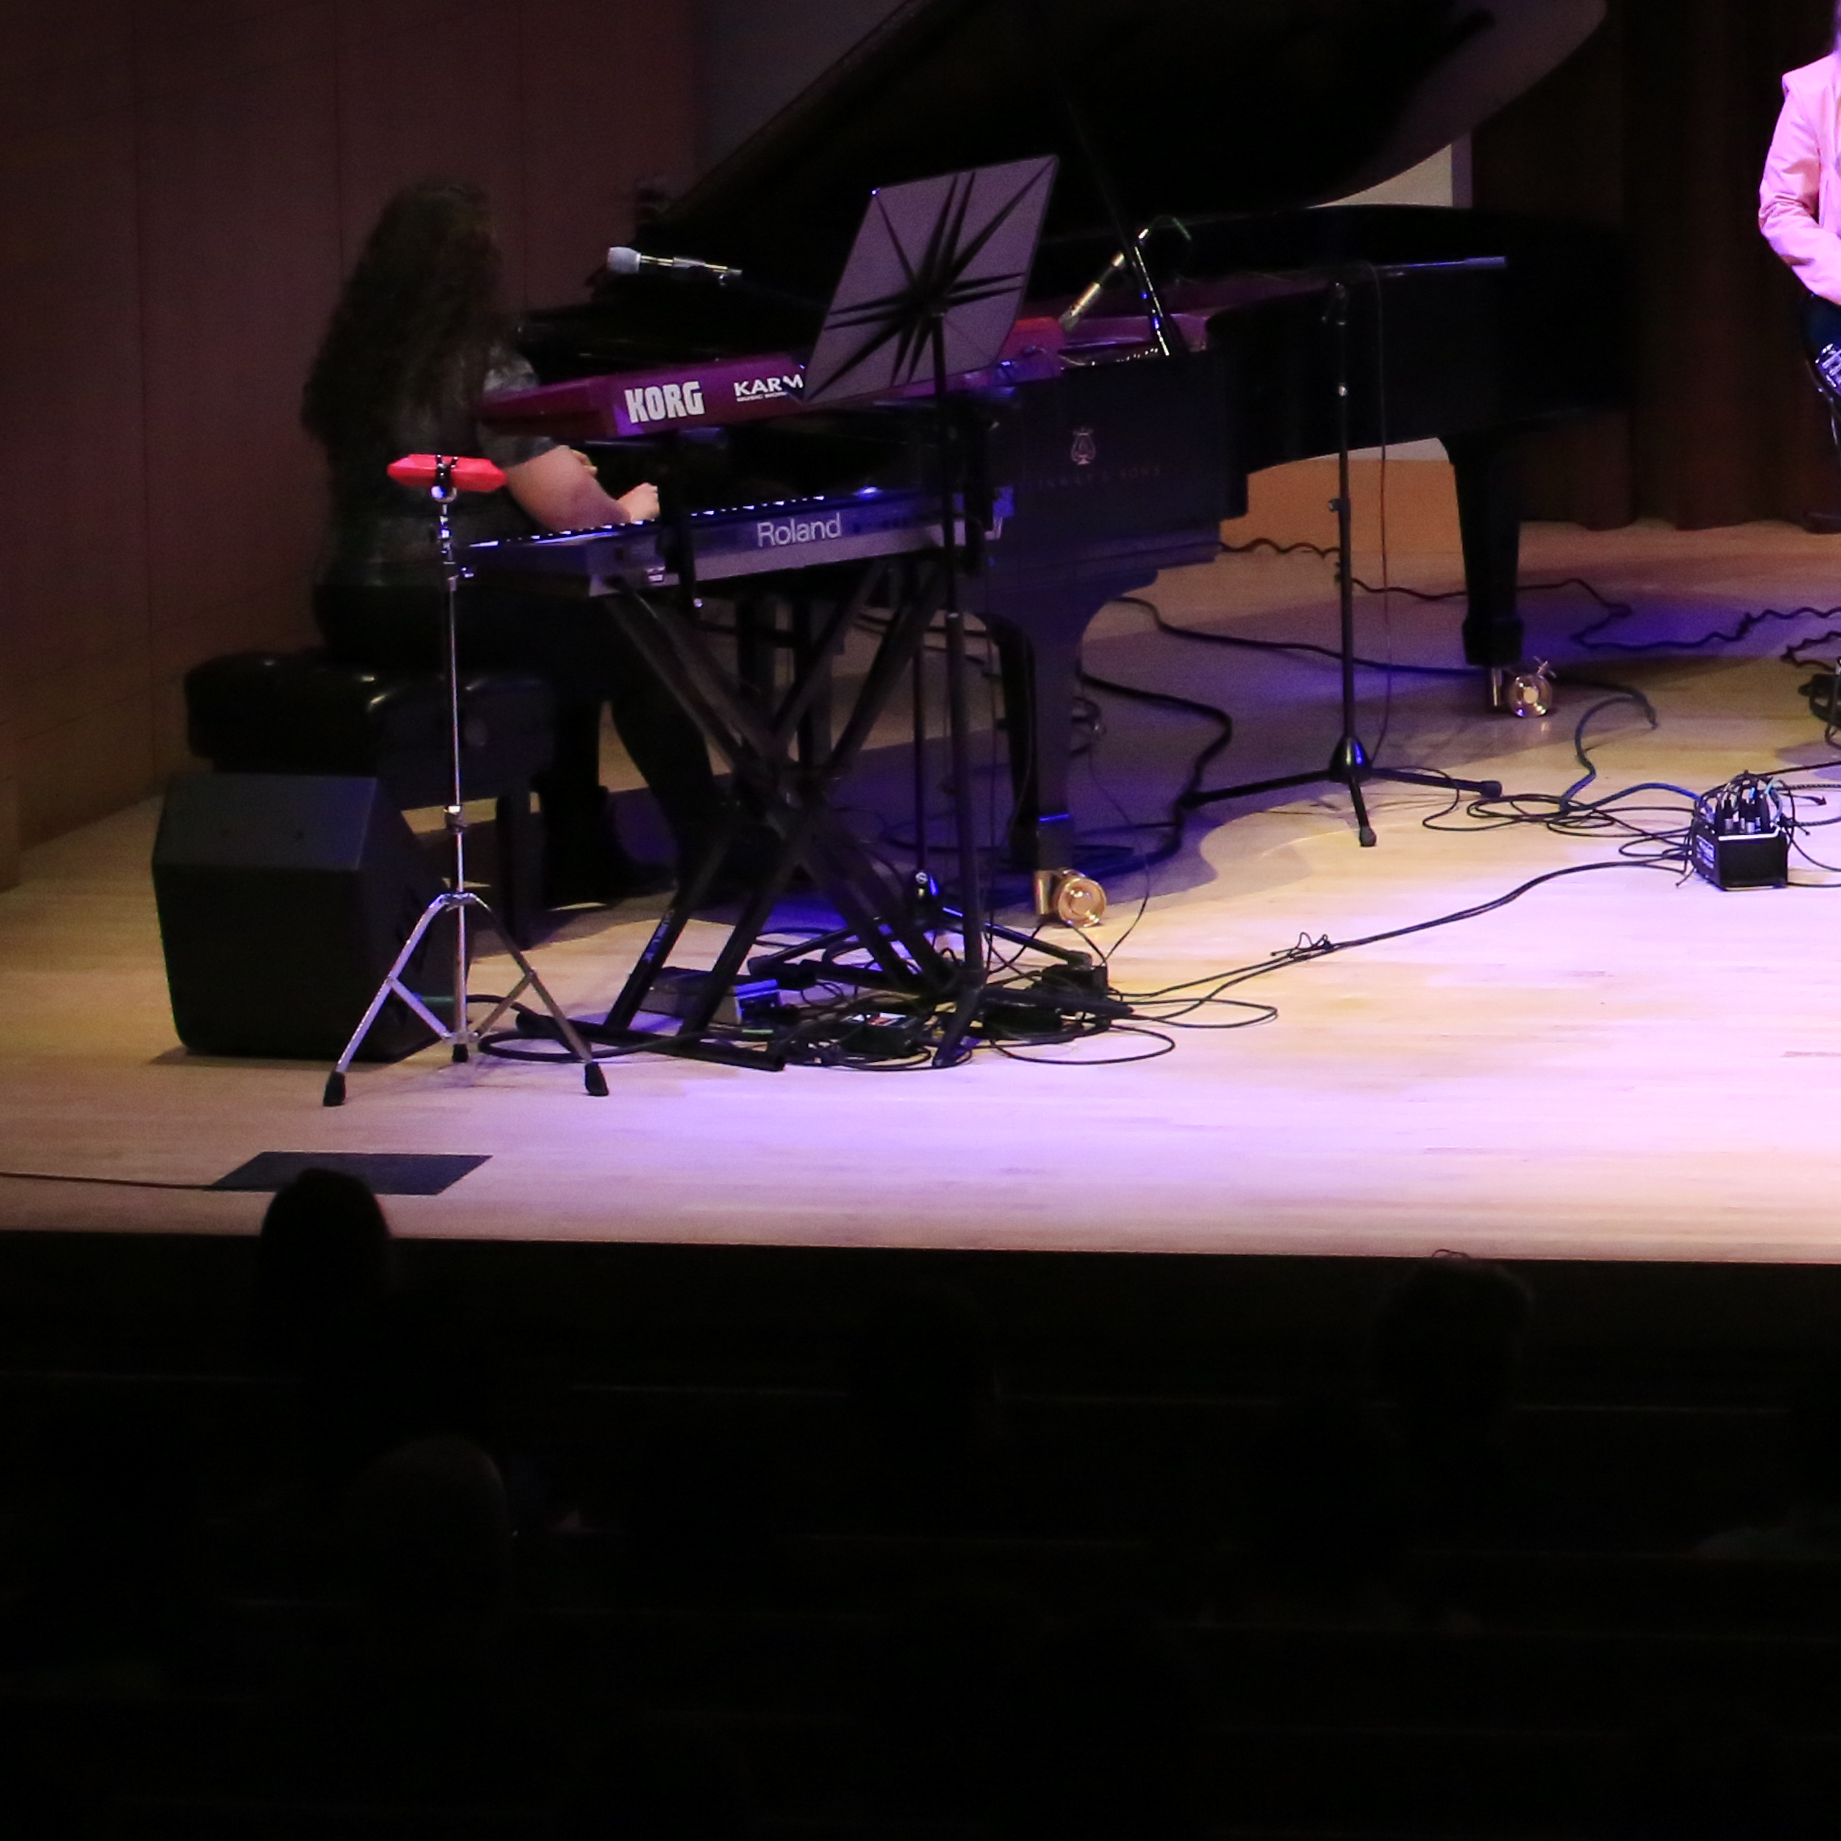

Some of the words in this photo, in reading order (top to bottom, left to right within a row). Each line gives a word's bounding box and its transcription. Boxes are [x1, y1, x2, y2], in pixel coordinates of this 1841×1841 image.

[624, 380, 706, 424] KORG
[733, 373, 804, 397] KARM
[756, 511, 842, 548] Roland
